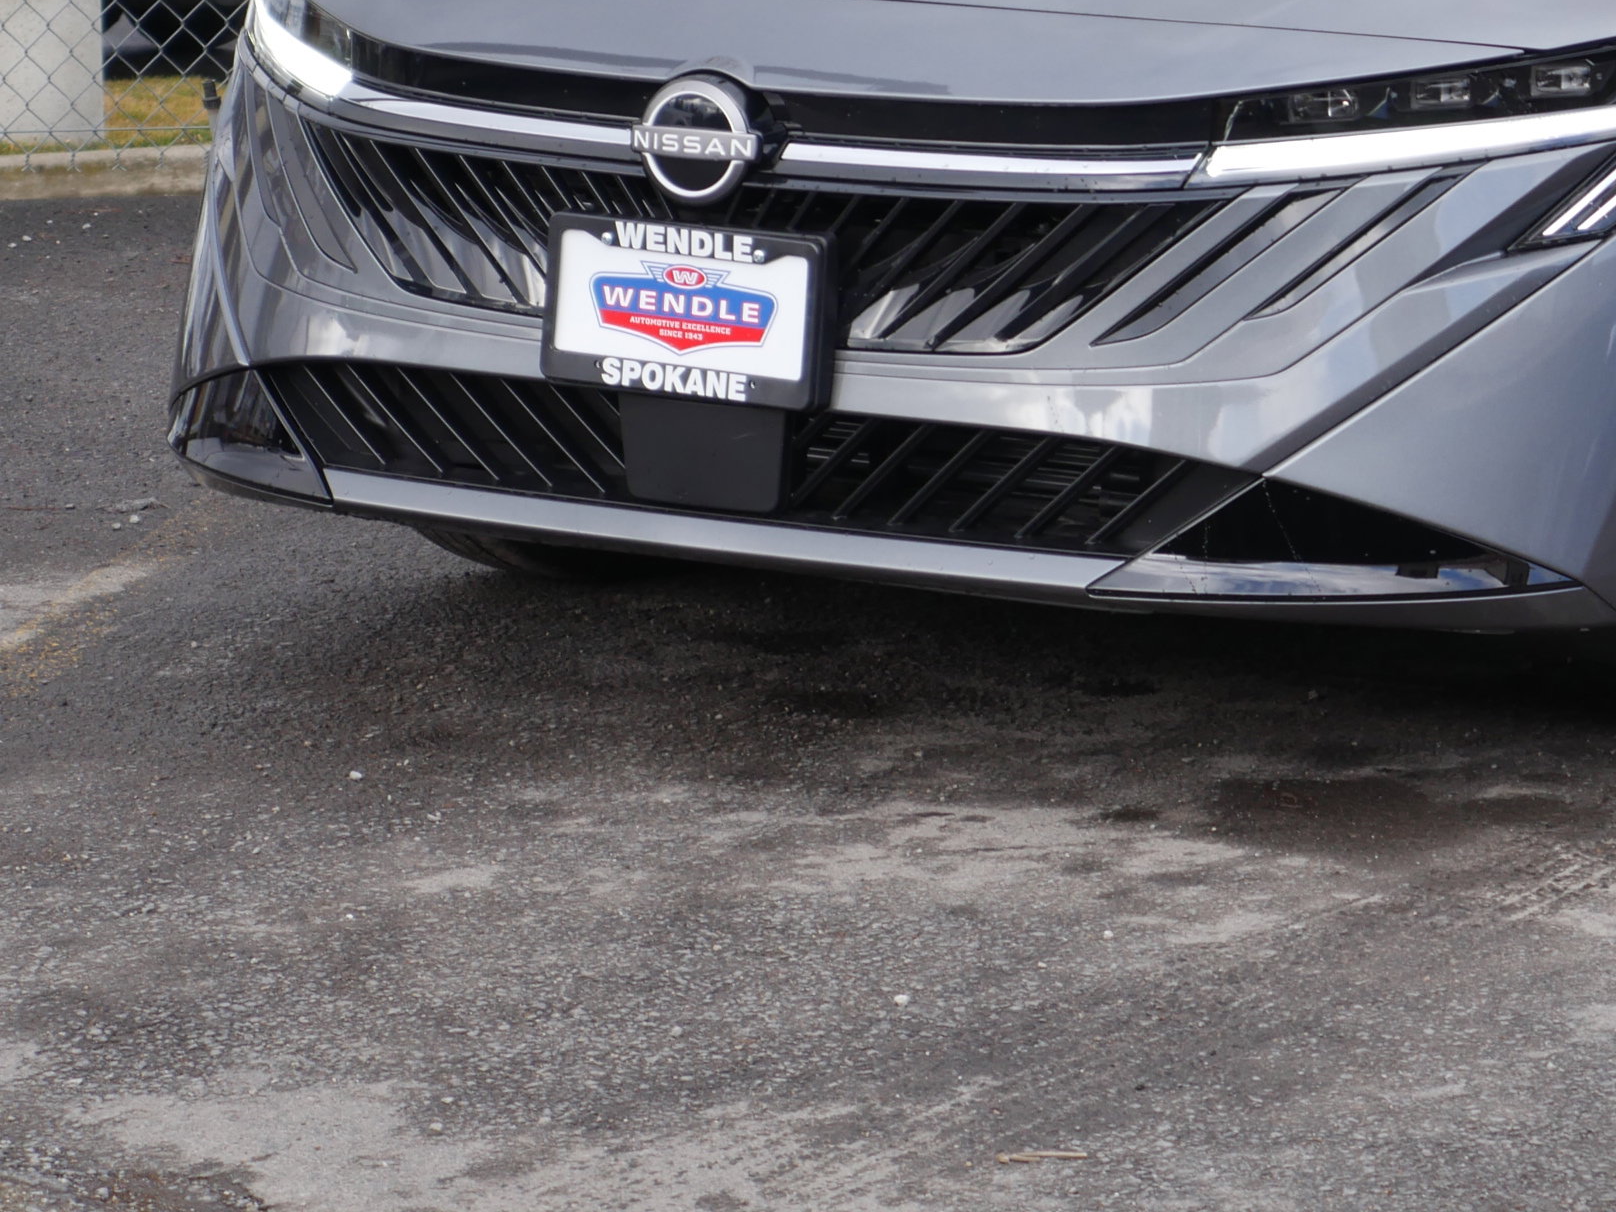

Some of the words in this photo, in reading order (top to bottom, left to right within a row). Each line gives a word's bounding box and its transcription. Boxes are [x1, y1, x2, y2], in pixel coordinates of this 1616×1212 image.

[633, 129, 753, 158] NISSAN
[615, 221, 753, 263] WENDLE
[602, 285, 760, 323] WENDLE
[629, 315, 681, 329] AUTOMOTIVE
[682, 322, 731, 335] EXCELLENCE
[659, 329, 683, 339] SINCE
[601, 357, 747, 402] SPOKANE
